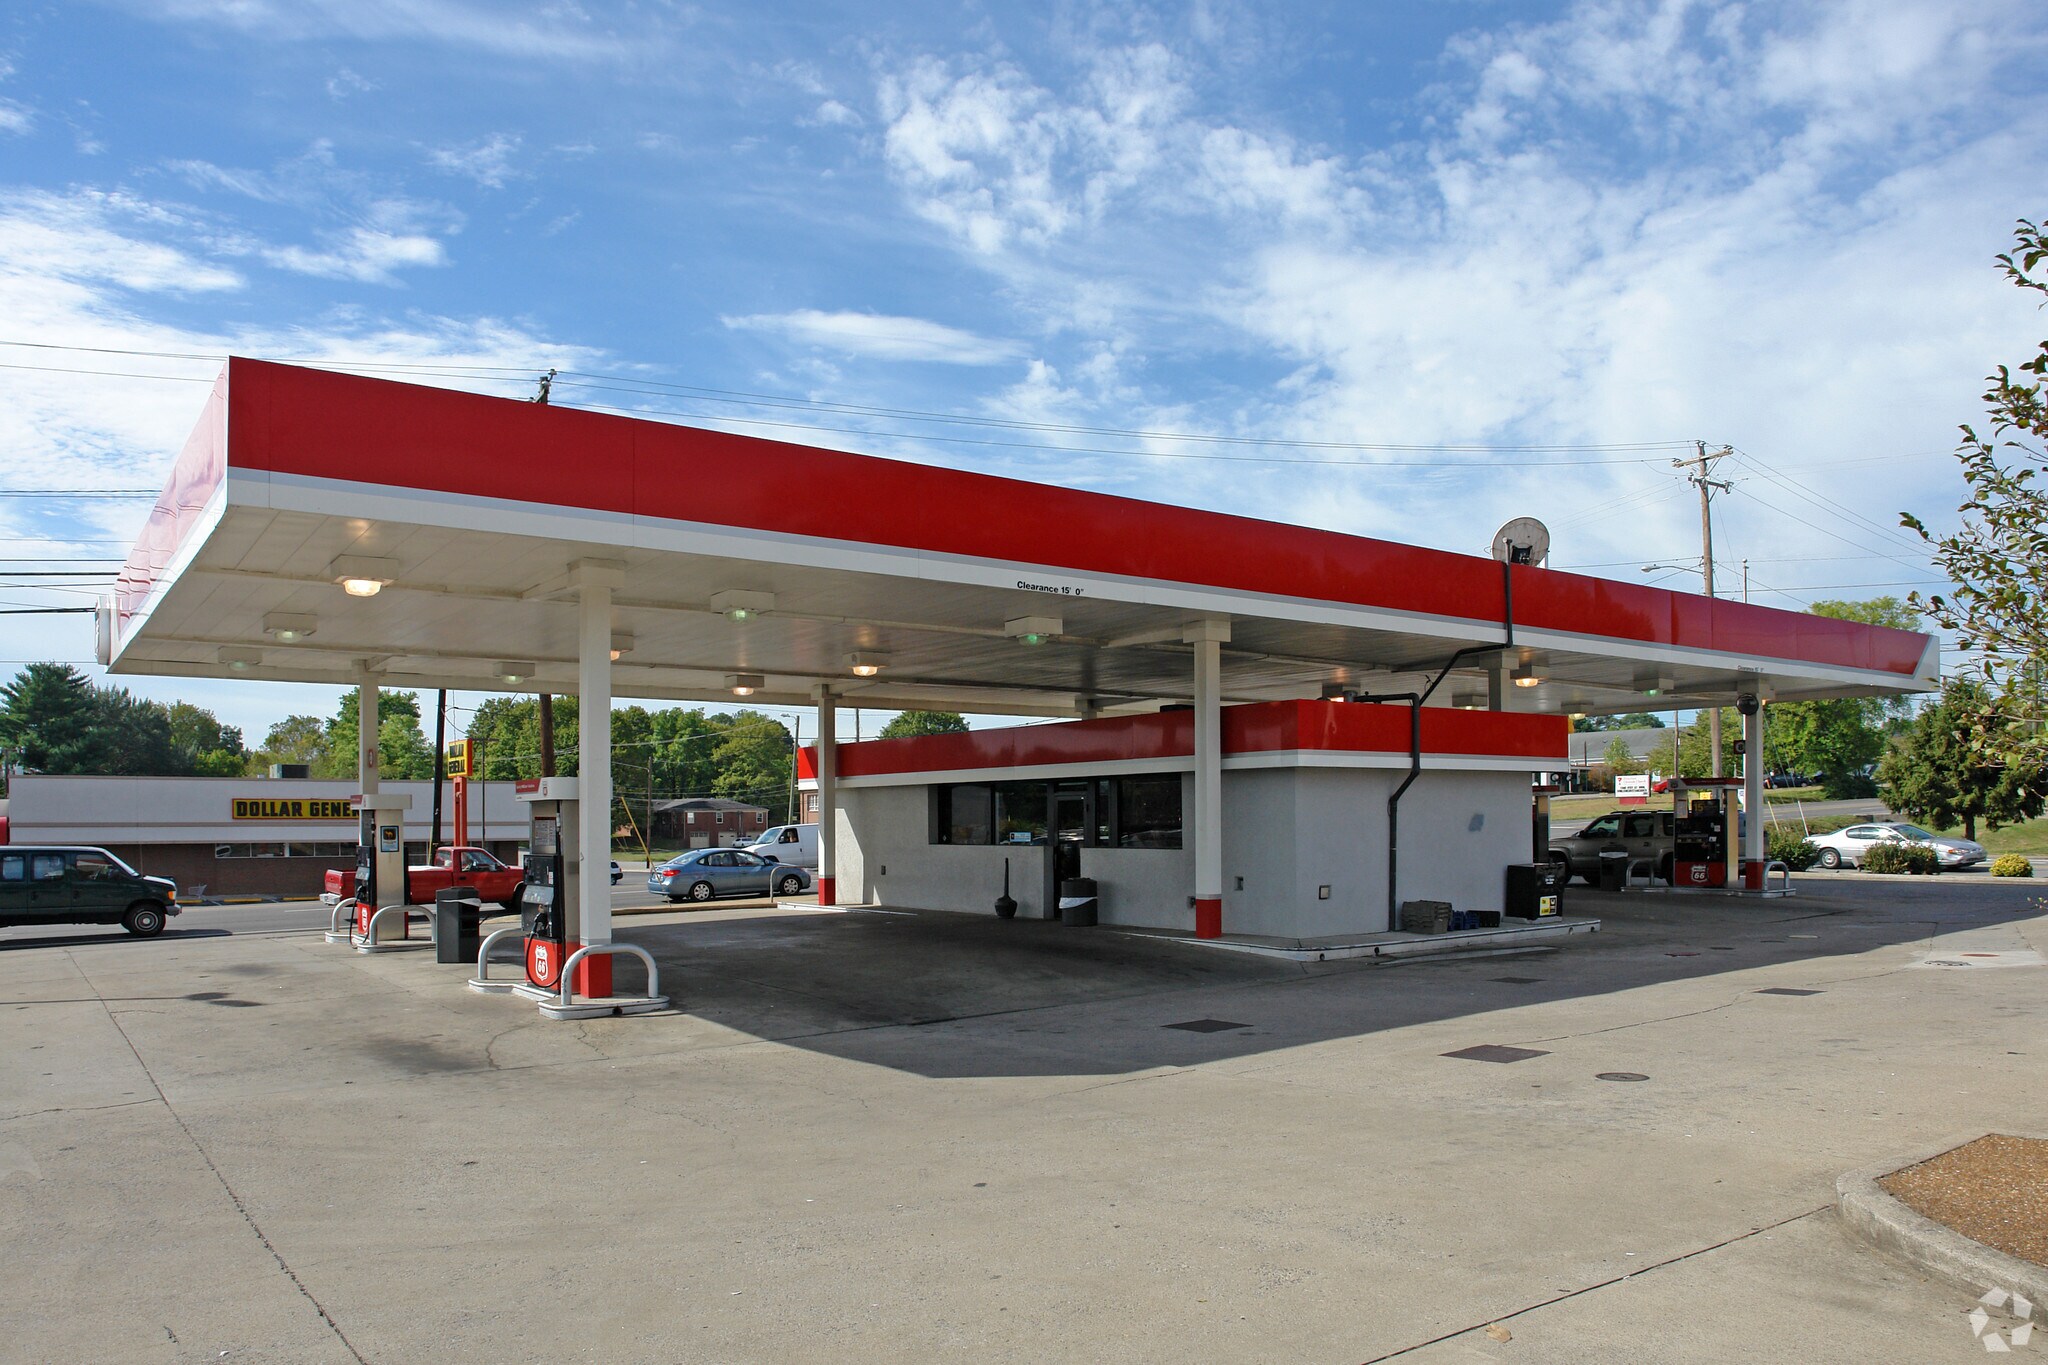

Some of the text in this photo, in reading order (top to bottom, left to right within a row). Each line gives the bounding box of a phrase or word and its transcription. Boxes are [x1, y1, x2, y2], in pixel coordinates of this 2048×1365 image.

[1017, 581, 1059, 593] Clearance
[1061, 586, 1072, 594] 15'
[236, 801, 302, 817] DOLLAR
[1694, 872, 1705, 880] 66
[537, 960, 546, 973] 66
